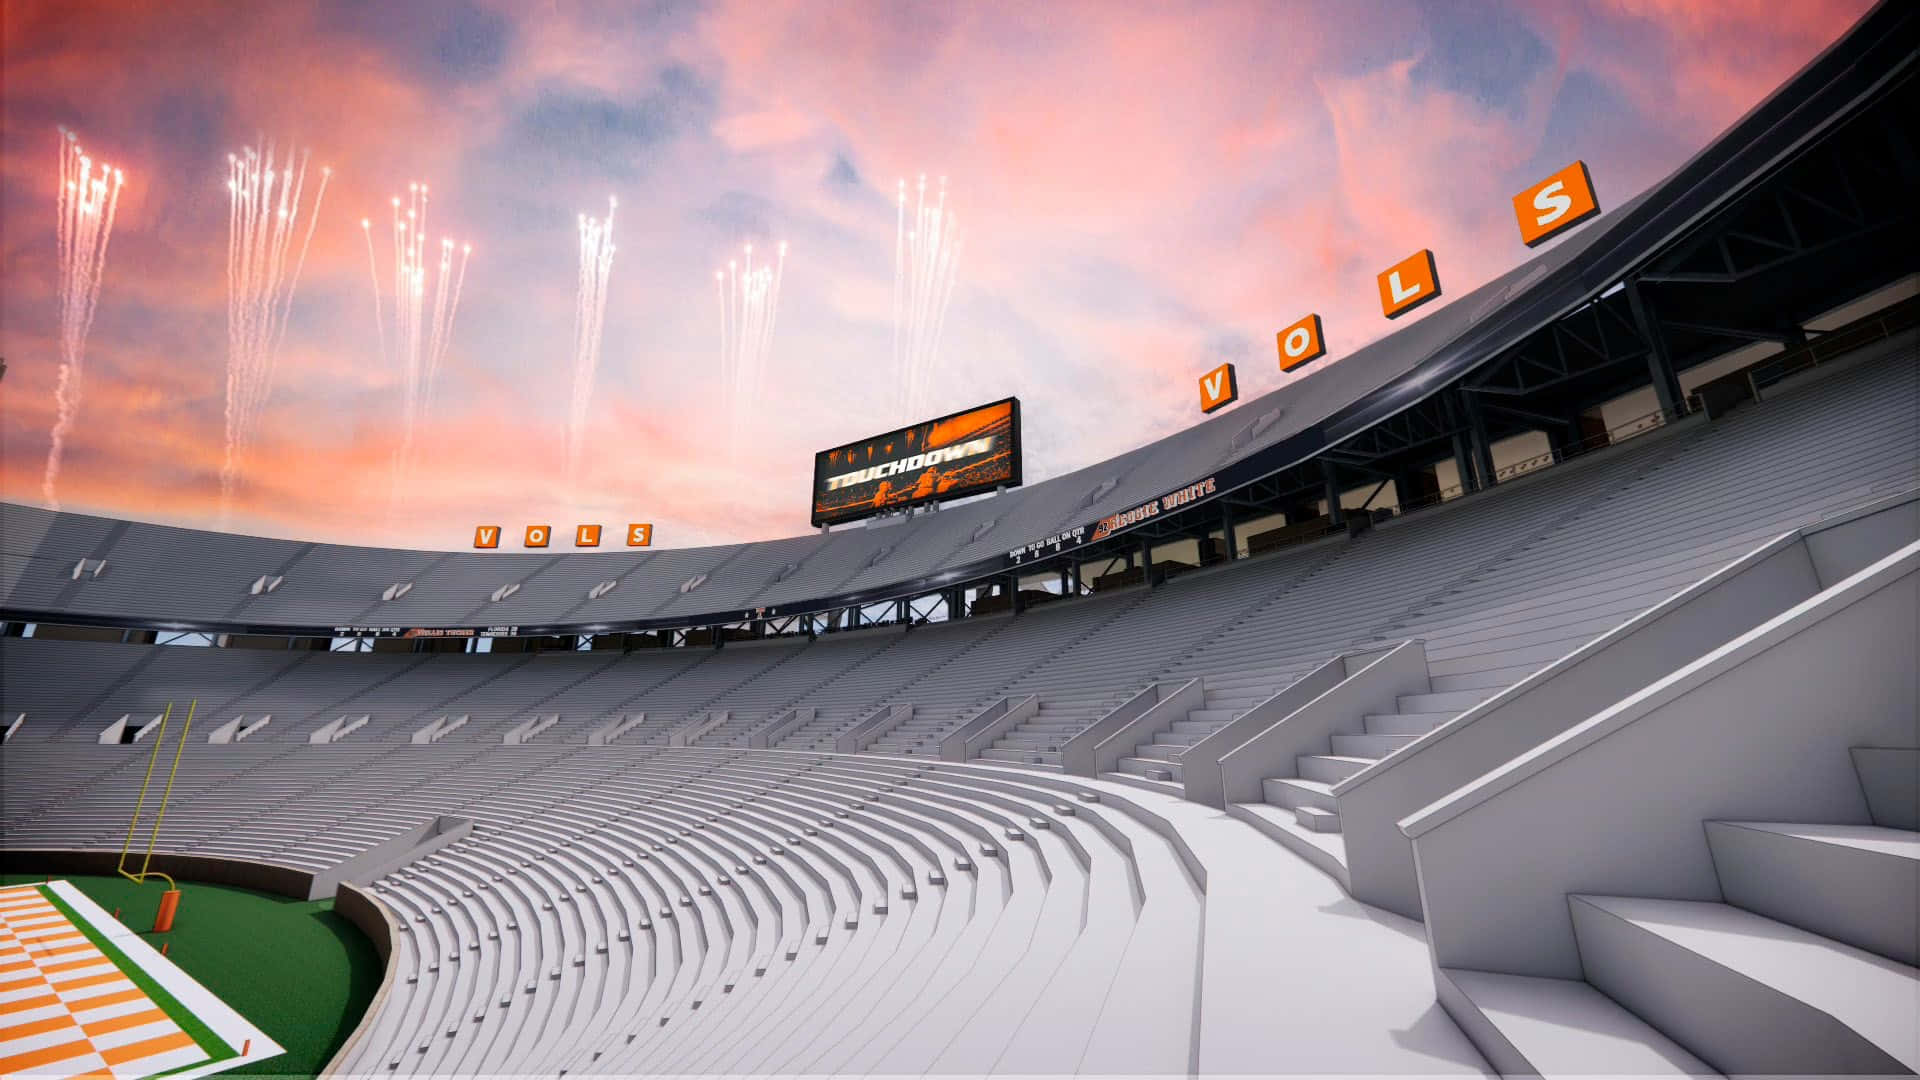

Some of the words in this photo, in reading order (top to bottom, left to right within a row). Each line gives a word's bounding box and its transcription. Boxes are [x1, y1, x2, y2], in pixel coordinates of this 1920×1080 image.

[826, 436, 996, 491] TOUCHDOWN
[1108, 500, 1160, 531] REGGIE
[1162, 477, 1217, 510] WHITE
[1009, 546, 1026, 559] DOWN
[1028, 543, 1036, 553] TO
[1036, 540, 1045, 549] GO
[1046, 534, 1061, 546] BALL
[1061, 530, 1071, 541] ON
[1072, 526, 1085, 538] QTR
